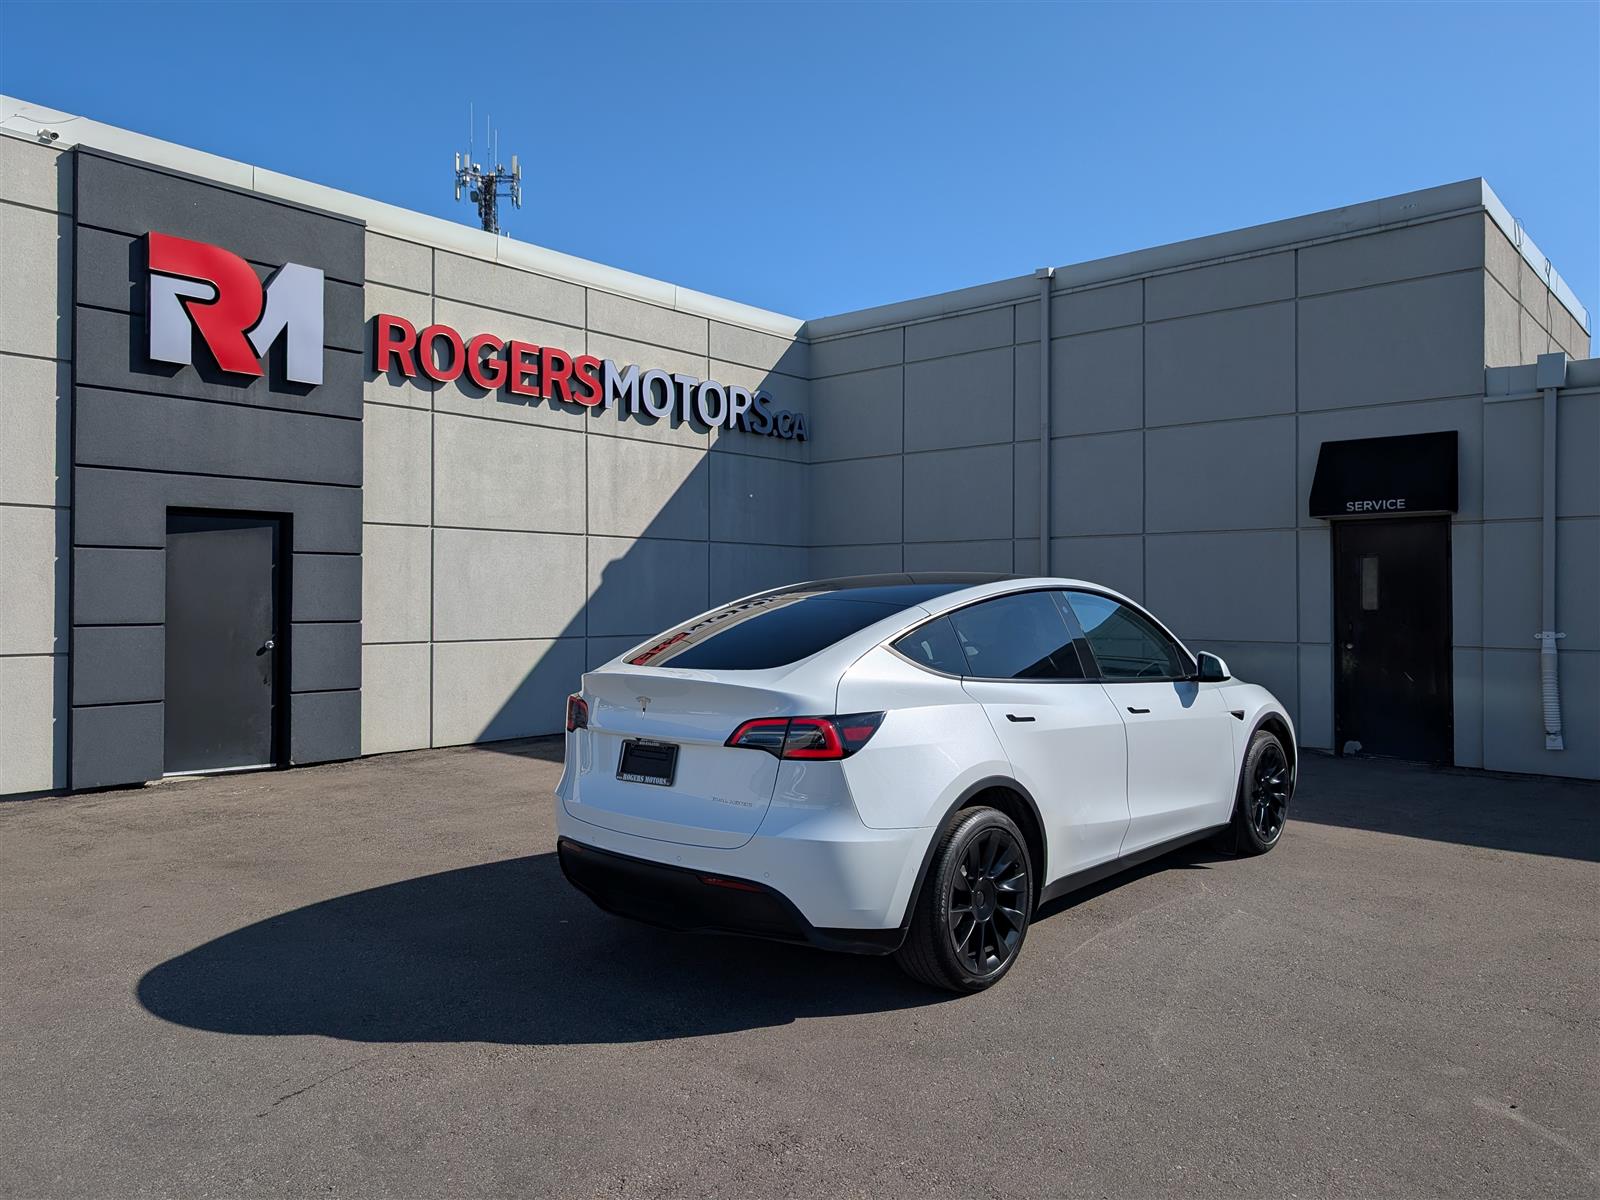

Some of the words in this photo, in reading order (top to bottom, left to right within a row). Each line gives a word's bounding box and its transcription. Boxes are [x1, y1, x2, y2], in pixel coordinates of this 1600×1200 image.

[149, 231, 325, 386] RM
[1346, 499, 1406, 512] SERVICE
[623, 773, 644, 783] ROGERS
[644, 776, 667, 785] MOTORS
